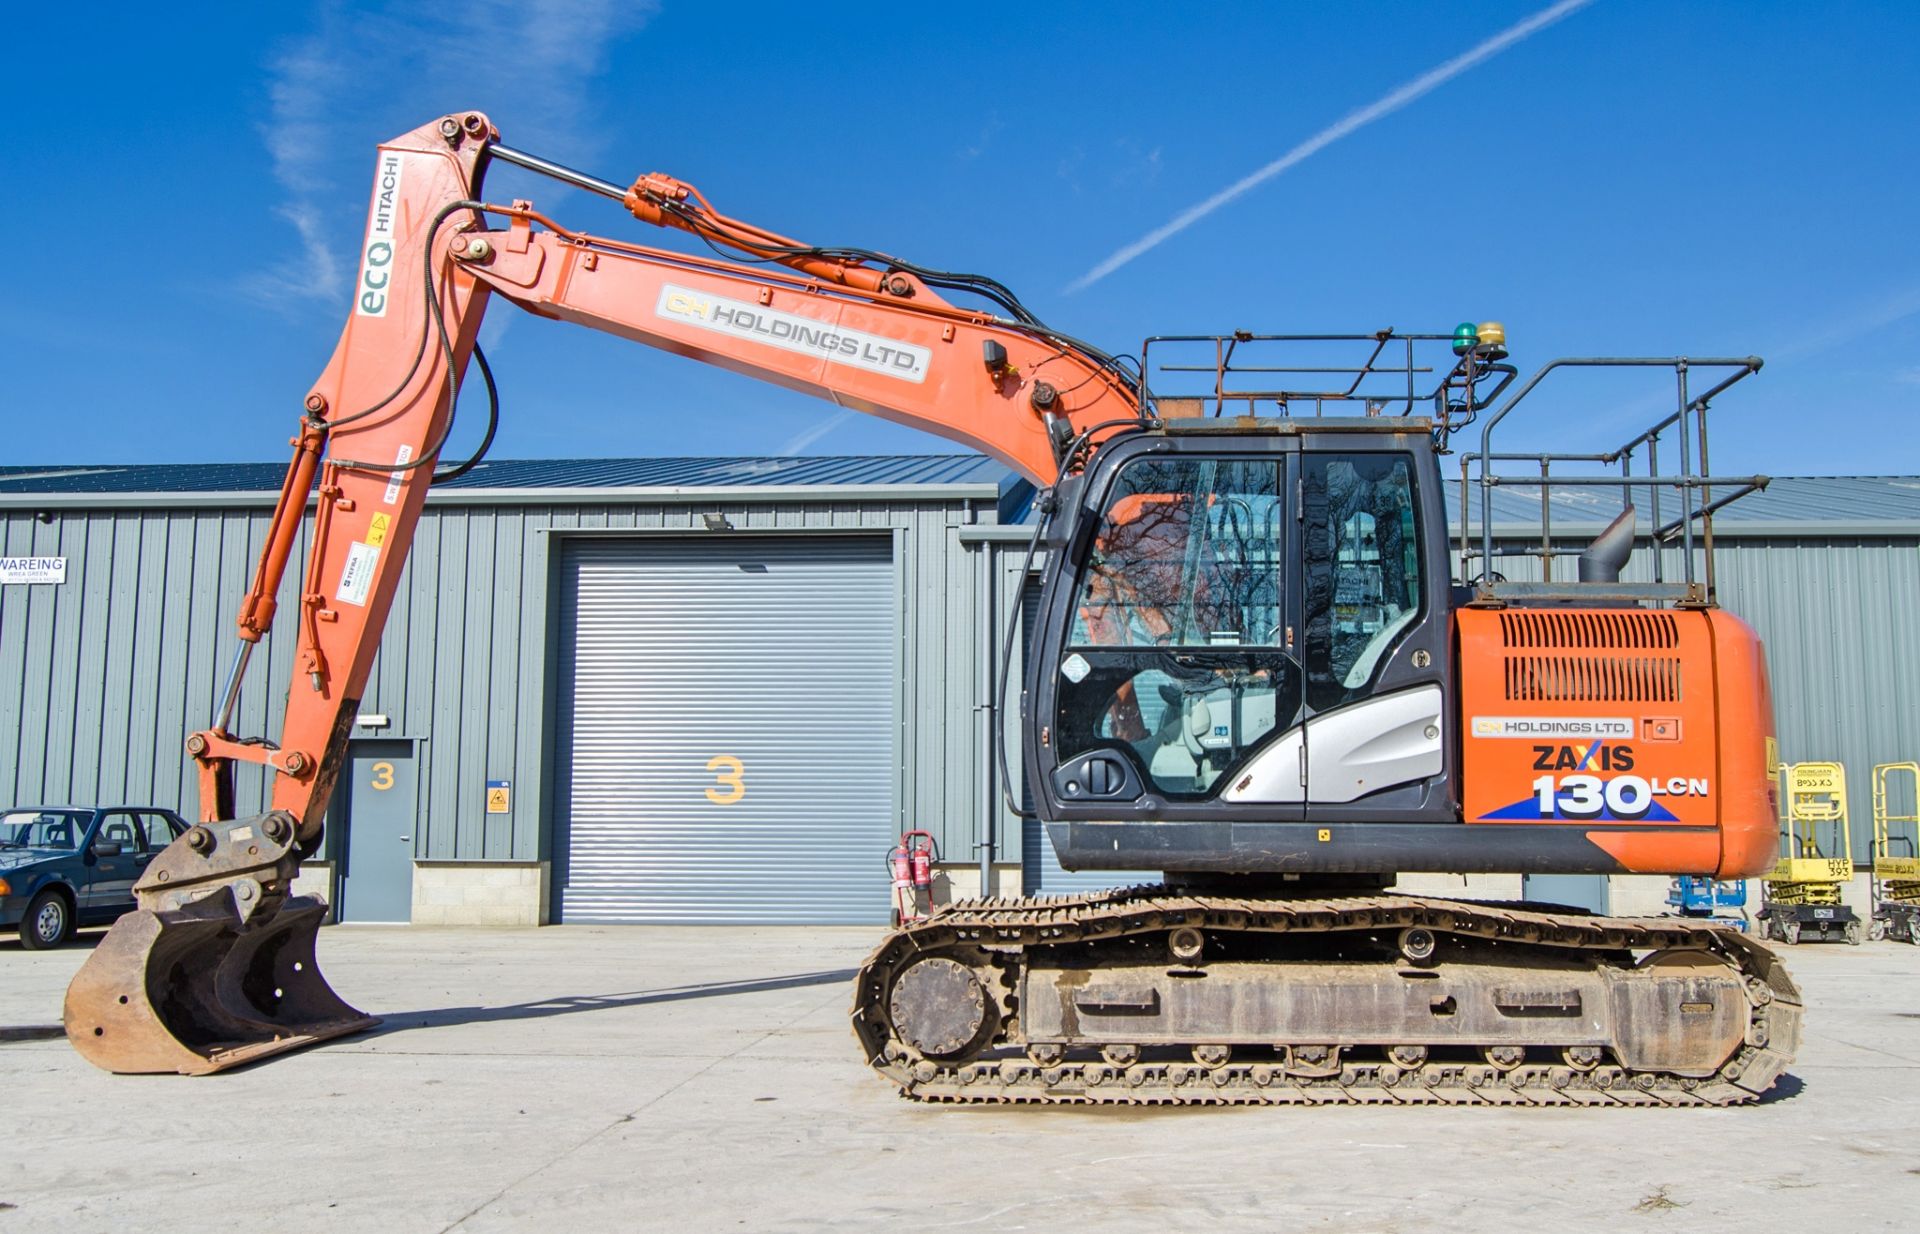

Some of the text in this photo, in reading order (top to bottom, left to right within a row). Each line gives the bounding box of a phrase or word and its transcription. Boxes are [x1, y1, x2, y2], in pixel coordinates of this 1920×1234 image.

[376, 157, 399, 232] HITACHI
[666, 293, 920, 373] CH HOLDINGS LTD.
[0, 558, 63, 570] WAREING
[1505, 721, 1592, 733] HOLDINGS
[1595, 722, 1630, 734] LTD.
[1533, 739, 1634, 772] ZAXIS
[371, 761, 394, 791] 3
[704, 755, 746, 805] 3
[1828, 859, 1849, 868] HYP
[1828, 868, 1849, 876] 393
